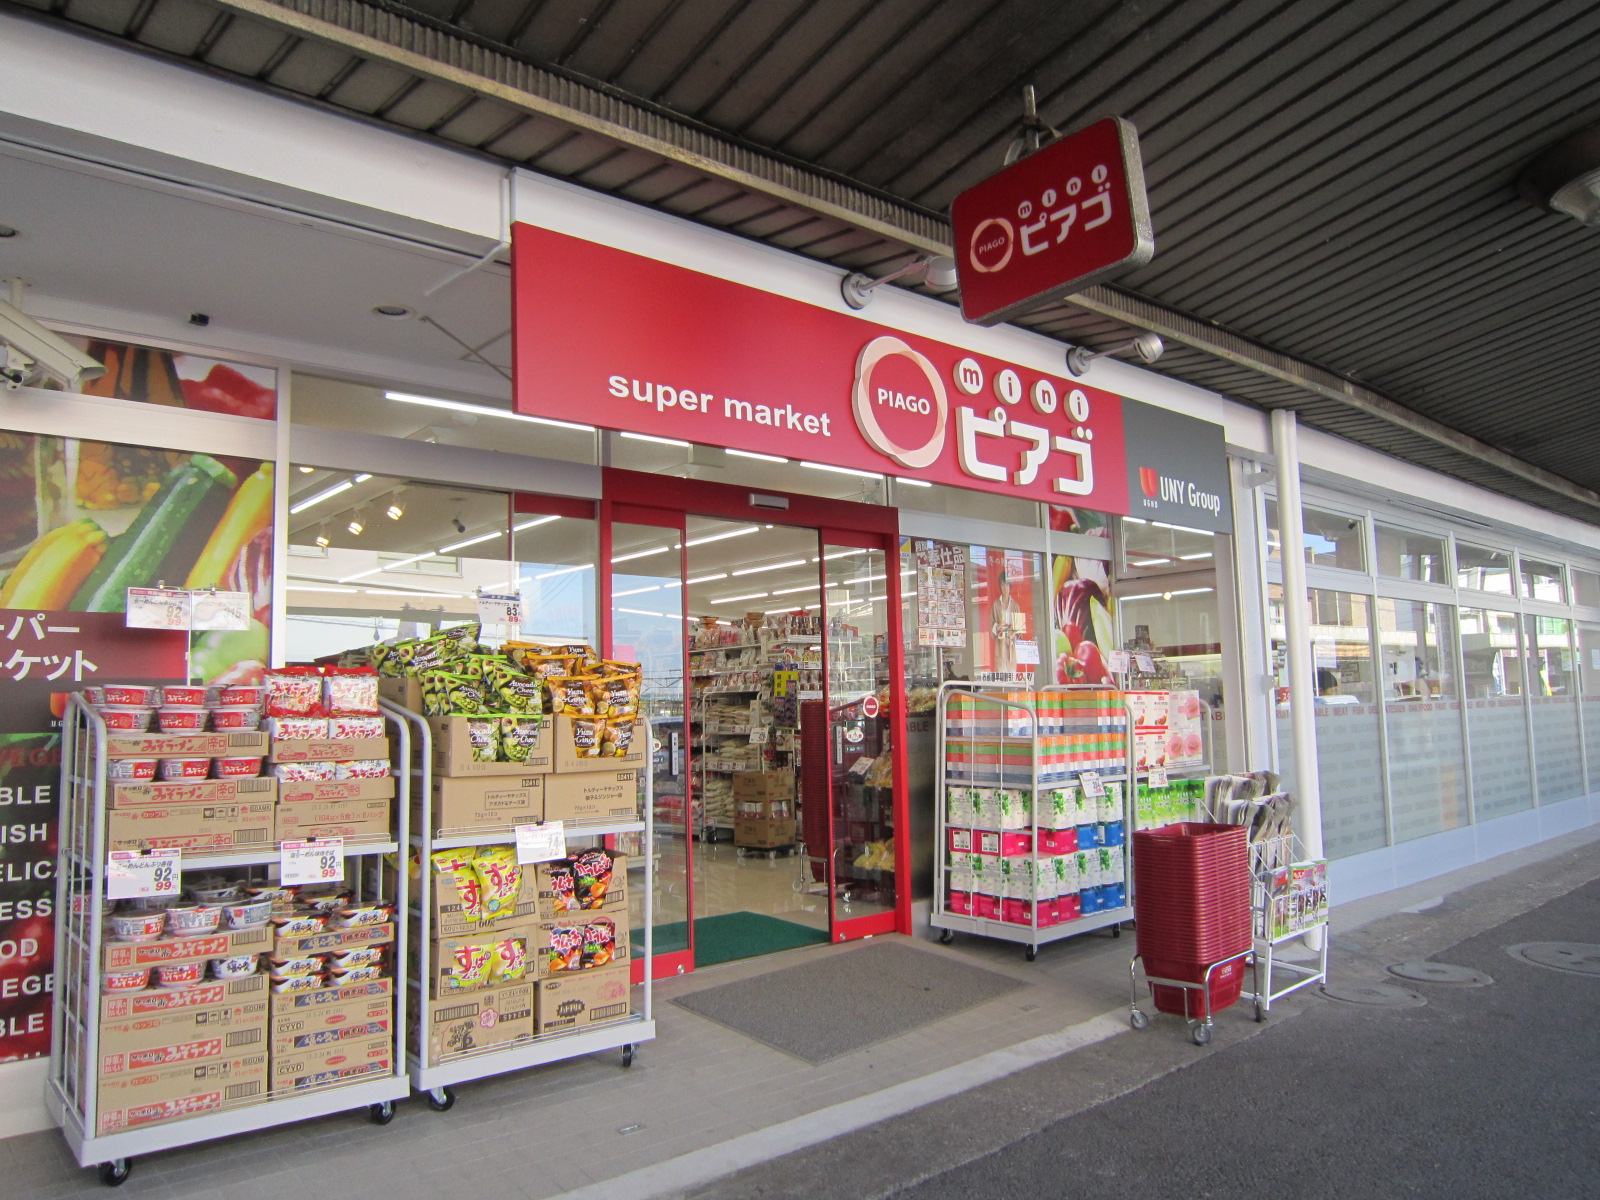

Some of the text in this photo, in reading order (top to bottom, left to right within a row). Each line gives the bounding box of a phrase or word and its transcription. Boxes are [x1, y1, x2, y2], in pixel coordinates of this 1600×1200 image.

[1019, 166, 1106, 217] mini
[1020, 182, 1112, 256] ピアゴ
[978, 237, 1005, 254] PIAGO
[957, 361, 1087, 421] mini
[608, 375, 831, 437] super market
[878, 388, 930, 415] PIAGO
[955, 406, 1094, 496] ピアゴ
[1160, 476, 1220, 517] UNY Group
[0, 613, 80, 640] パー
[0, 649, 98, 681] ケット
[509, 680, 538, 688] Avocado
[567, 688, 584, 696] Yuzu
[1275, 709, 1289, 719] RUIT
[1333, 706, 1348, 716] MEAT
[1353, 705, 1365, 715] FISH
[1409, 703, 1433, 712] DAILYFOOD
[576, 728, 593, 736] Yuzu
[907, 721, 929, 732] BLE
[141, 739, 193, 752] みそラーメン
[151, 785, 204, 801] みそラーメン
[1, 823, 47, 843] ISH
[171, 937, 228, 958] みそラーメン
[111, 975, 146, 988] みそラーメン
[168, 988, 225, 1008] みそラーメン
[279, 1022, 302, 1031] CYYD
[165, 1040, 222, 1061] みそラーメン
[279, 1063, 302, 1072] CYYD
